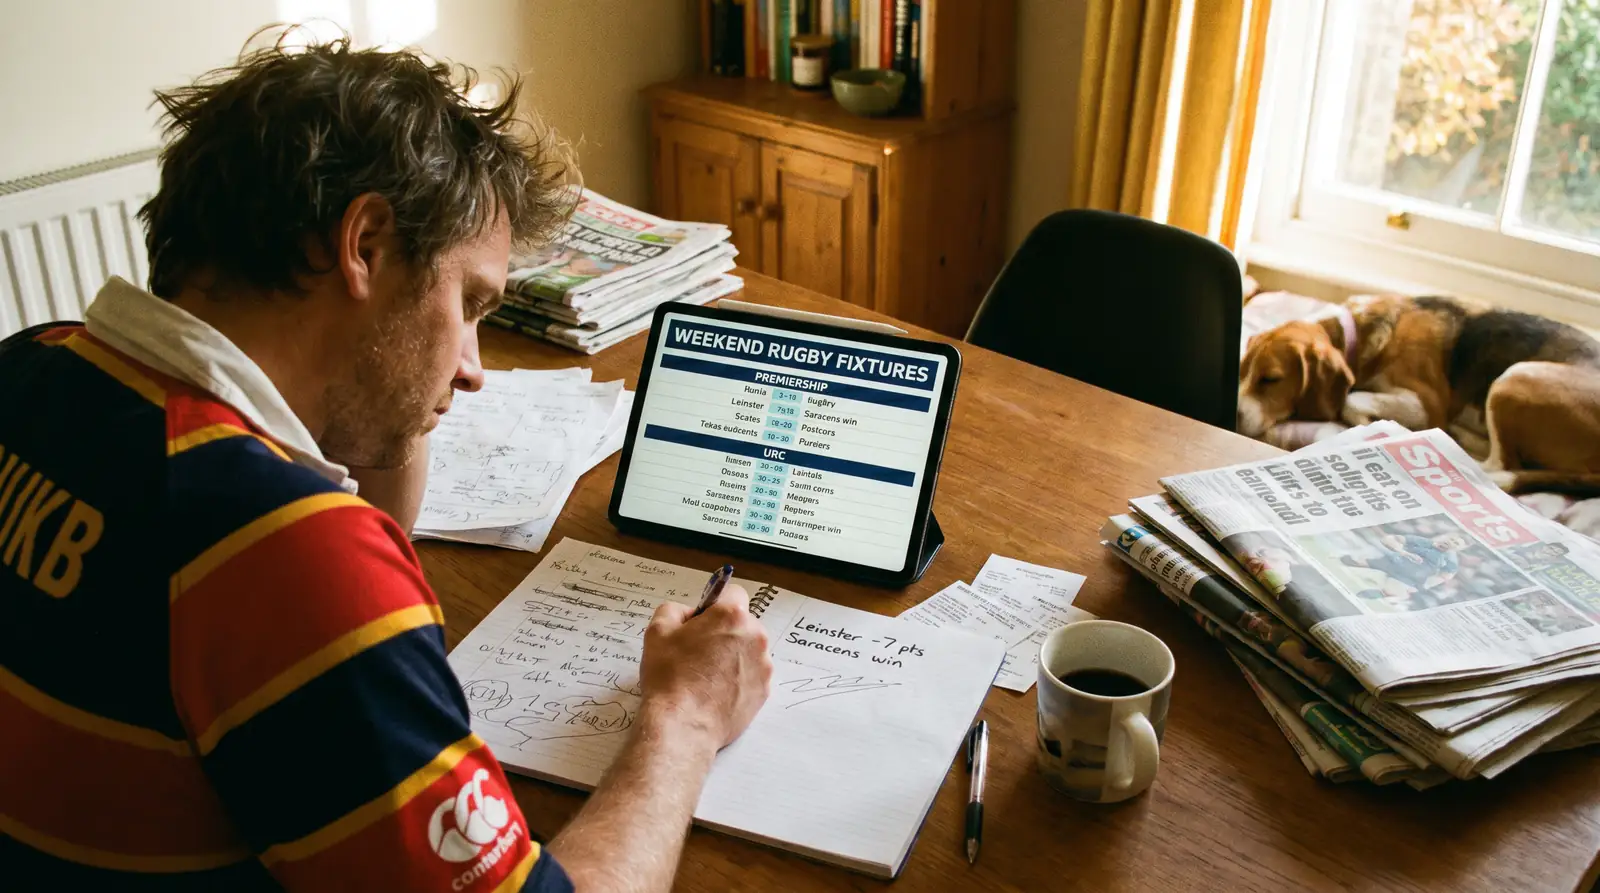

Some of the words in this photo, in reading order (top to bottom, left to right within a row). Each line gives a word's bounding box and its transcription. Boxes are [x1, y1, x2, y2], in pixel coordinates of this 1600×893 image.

[674, 327, 764, 355] WEEKEND
[767, 342, 834, 367] RUGBY
[836, 353, 929, 382] FIXTURES
[755, 371, 828, 392] PREMIERSHIP
[731, 398, 765, 410] Leinster
[735, 412, 761, 424] Scates
[804, 410, 841, 423] Saracens
[843, 417, 858, 426] win
[801, 424, 836, 437] Postcors
[764, 448, 786, 461] URC
[1392, 490, 1422, 509] on
[1400, 445, 1519, 543] Sports
[1302, 499, 1328, 517] to
[827, 526, 842, 534] win
[794, 616, 863, 641] Leinster
[898, 643, 924, 657] pts
[785, 631, 860, 659] Saracens
[871, 655, 902, 668] win
